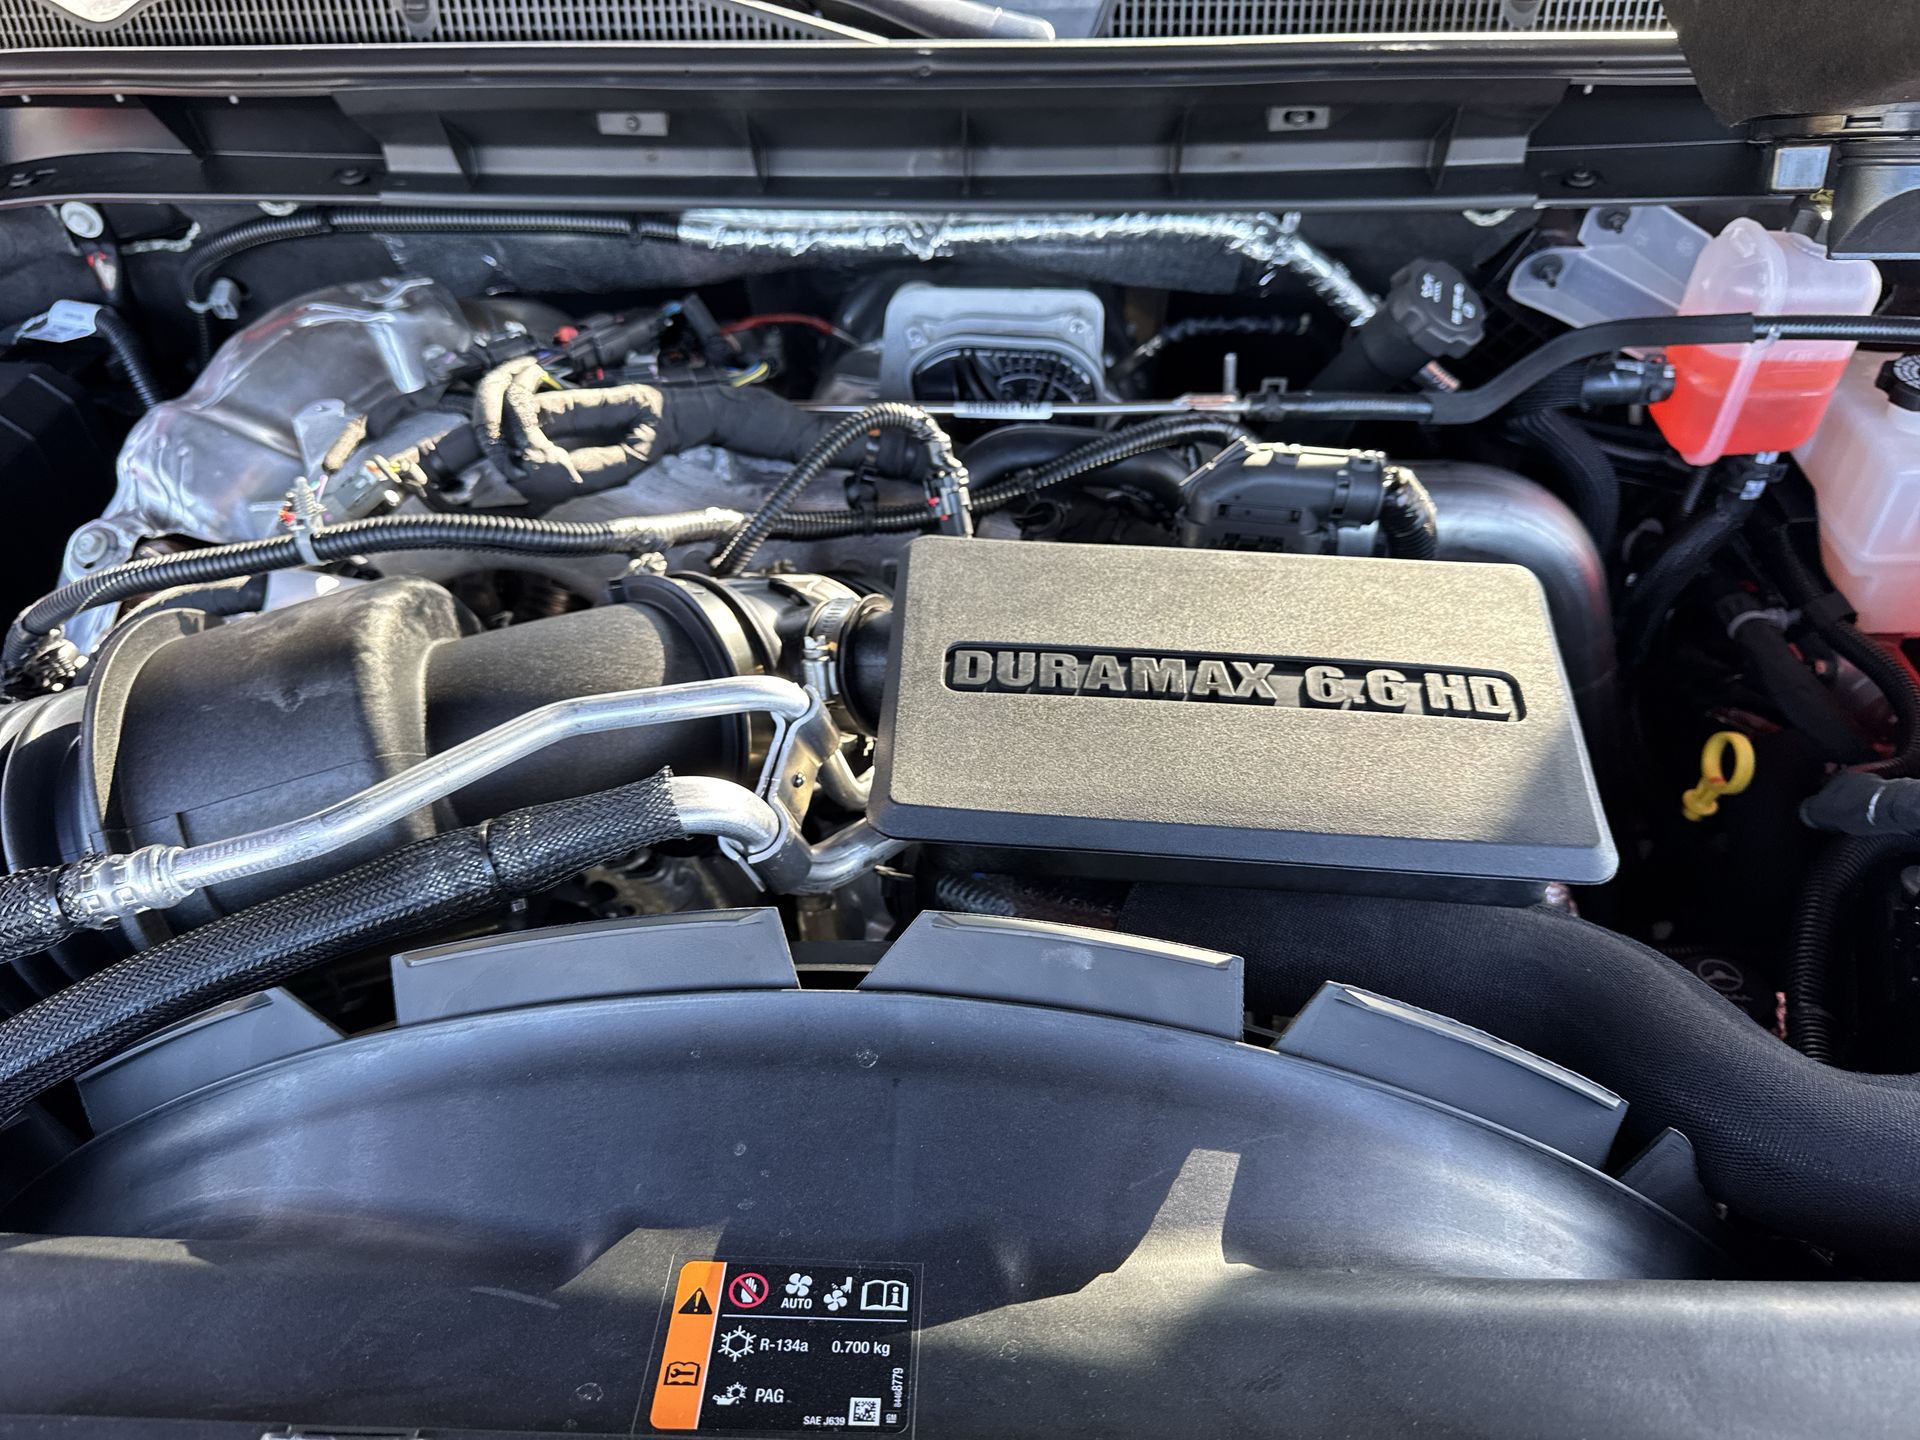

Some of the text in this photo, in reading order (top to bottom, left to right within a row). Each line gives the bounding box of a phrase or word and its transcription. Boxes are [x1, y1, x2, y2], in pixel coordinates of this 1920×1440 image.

[951, 648, 1514, 716] DURAMAX 6.6 HD
[780, 1297, 813, 1310] AUTO
[759, 1338, 891, 1357] R-134a 0.700 kg
[754, 1388, 785, 1403] PAG
[803, 1416, 846, 1427] SAE J639
